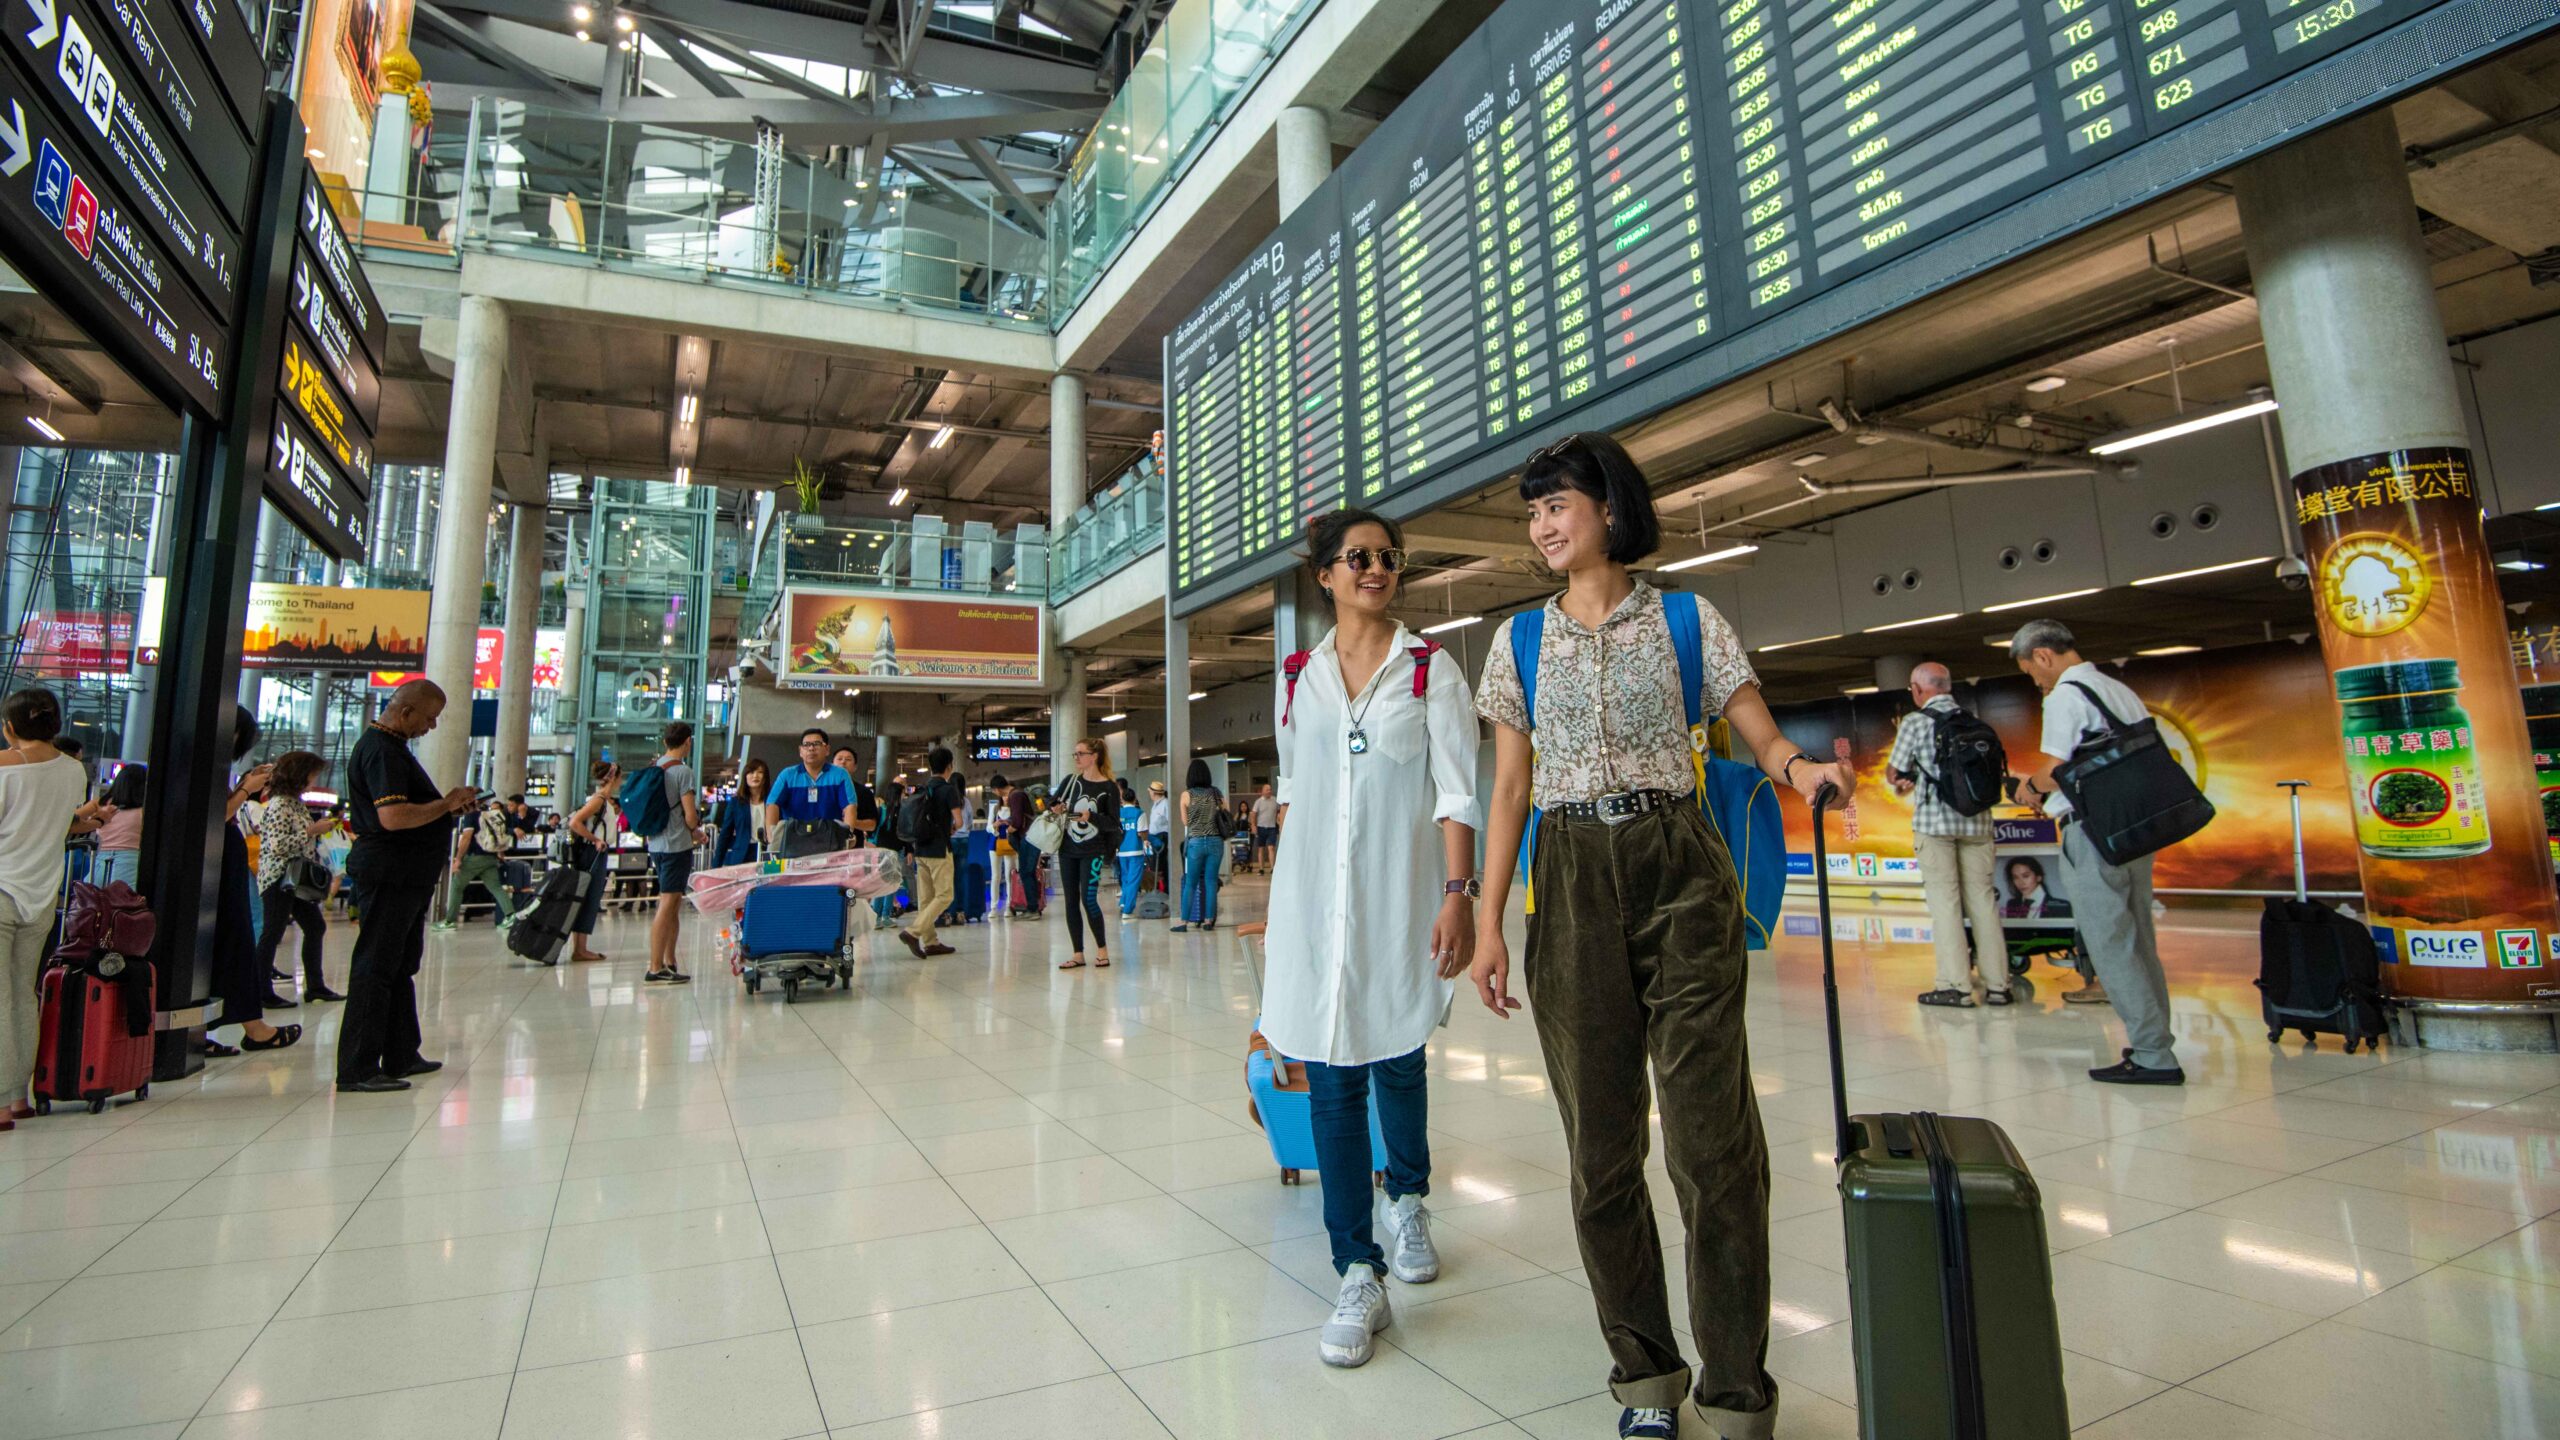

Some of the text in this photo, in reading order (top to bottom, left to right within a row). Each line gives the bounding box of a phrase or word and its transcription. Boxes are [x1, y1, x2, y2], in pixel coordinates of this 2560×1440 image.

[1665, 4, 1676, 21] C
[113, 0, 155, 66] Car Rent
[1732, 16, 1761, 49] 15:05
[2064, 19, 2094, 47] TG
[2071, 10, 2179, 81] PG 948
[1535, 43, 1572, 86] ARRIVES
[1734, 41, 1764, 73] 15:05
[1737, 66, 1767, 98] 15:05
[2076, 44, 2187, 112] TG 671
[2082, 0, 2357, 145] TG 623 15:30
[1478, 178, 1489, 194] CZ
[1667, 28, 1678, 45] B
[1507, 88, 1520, 110] NO
[1675, 97, 1686, 115] B
[1740, 91, 1770, 123] 15:15
[1467, 110, 1494, 144] FLIGHT
[1479, 198, 1491, 213] TG
[1670, 51, 1681, 68] B
[1677, 120, 1688, 137] C
[1743, 118, 1773, 148] 15:20
[1480, 219, 1492, 233] TR
[1673, 73, 1684, 90] C
[1746, 144, 1777, 174] 15:20
[109, 130, 168, 219] Public Transportations
[1409, 168, 1429, 194] FROM
[1682, 168, 1693, 185] C
[1749, 170, 1780, 199] 15:20
[1555, 221, 1578, 246] 20:15
[1680, 145, 1690, 162] B
[1684, 194, 1695, 211] B
[1751, 195, 1783, 225] 15:25
[1357, 218, 1371, 239] TIME
[1754, 222, 1786, 252] 15:25
[100, 207, 162, 293] รถไฟฟ้าเข้าเมือง
[1271, 241, 1285, 277] B
[1329, 244, 1341, 263] EXIT
[1757, 250, 1788, 278] 15:30
[91, 252, 145, 319] Airport Rail Link
[1301, 260, 1325, 287] REMARKS
[1488, 338, 1499, 353] PG
[1561, 288, 1583, 310] 14:30
[1687, 218, 1698, 235] B
[1760, 276, 1791, 305] 15:35
[1489, 357, 1501, 372] TG
[1563, 309, 1584, 332] 15:05
[1690, 243, 1700, 259] B
[1175, 330, 1208, 367] International
[1208, 310, 1231, 337] Arrivals
[1230, 296, 1247, 317] Door
[1490, 379, 1501, 393] VZ
[1516, 363, 1530, 380] 961
[1564, 332, 1586, 355] 14:50
[1692, 268, 1702, 285] B
[1490, 398, 1504, 415] MU
[1518, 384, 1532, 401] 741
[1565, 354, 1588, 377] 14:40
[1694, 292, 1705, 309] C
[1492, 420, 1504, 435] TG
[1567, 377, 1589, 399] 14:35
[1696, 318, 1707, 335] B
[249, 598, 355, 611] come to Thailand
[917, 657, 1034, 677] Welcome to Thailand
[791, 681, 832, 690] JCDecaux
[1827, 857, 1849, 868] ure
[1861, 858, 1872, 876] 7
[1885, 861, 1907, 870] SAVE
[2411, 936, 2479, 958] pure
[2507, 936, 2530, 967] 7
